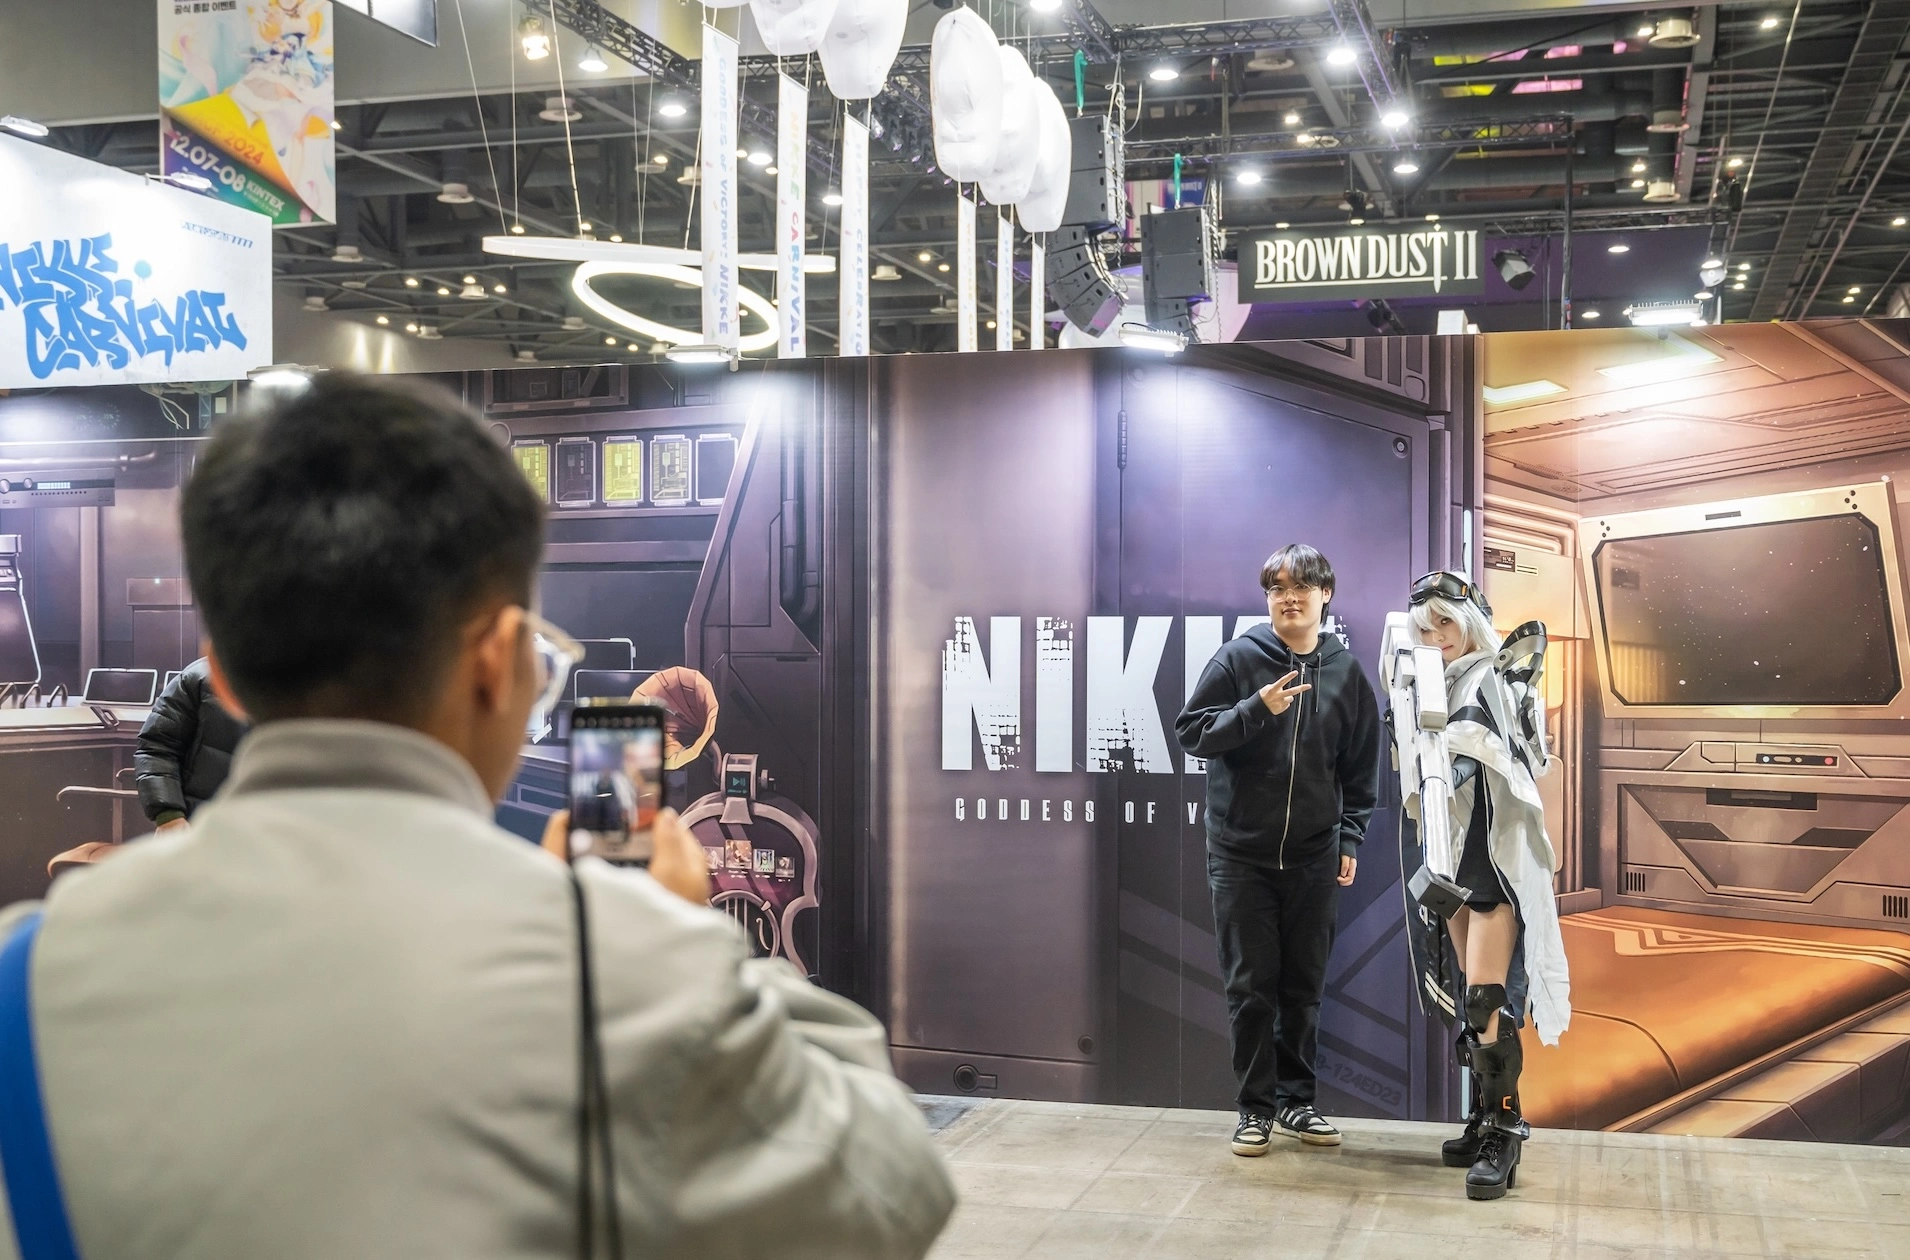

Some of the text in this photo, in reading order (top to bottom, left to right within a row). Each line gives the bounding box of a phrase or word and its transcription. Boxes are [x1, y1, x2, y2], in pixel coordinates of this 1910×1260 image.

[224, 131, 265, 166] 2024
[246, 180, 286, 213] KINTEX
[790, 212, 801, 351] CARNIVAL
[1255, 226, 1479, 290] BROWN DUST II
[719, 264, 729, 335] NIKKE
[955, 797, 1096, 823] GODDESS
[1124, 800, 1157, 825] OF
